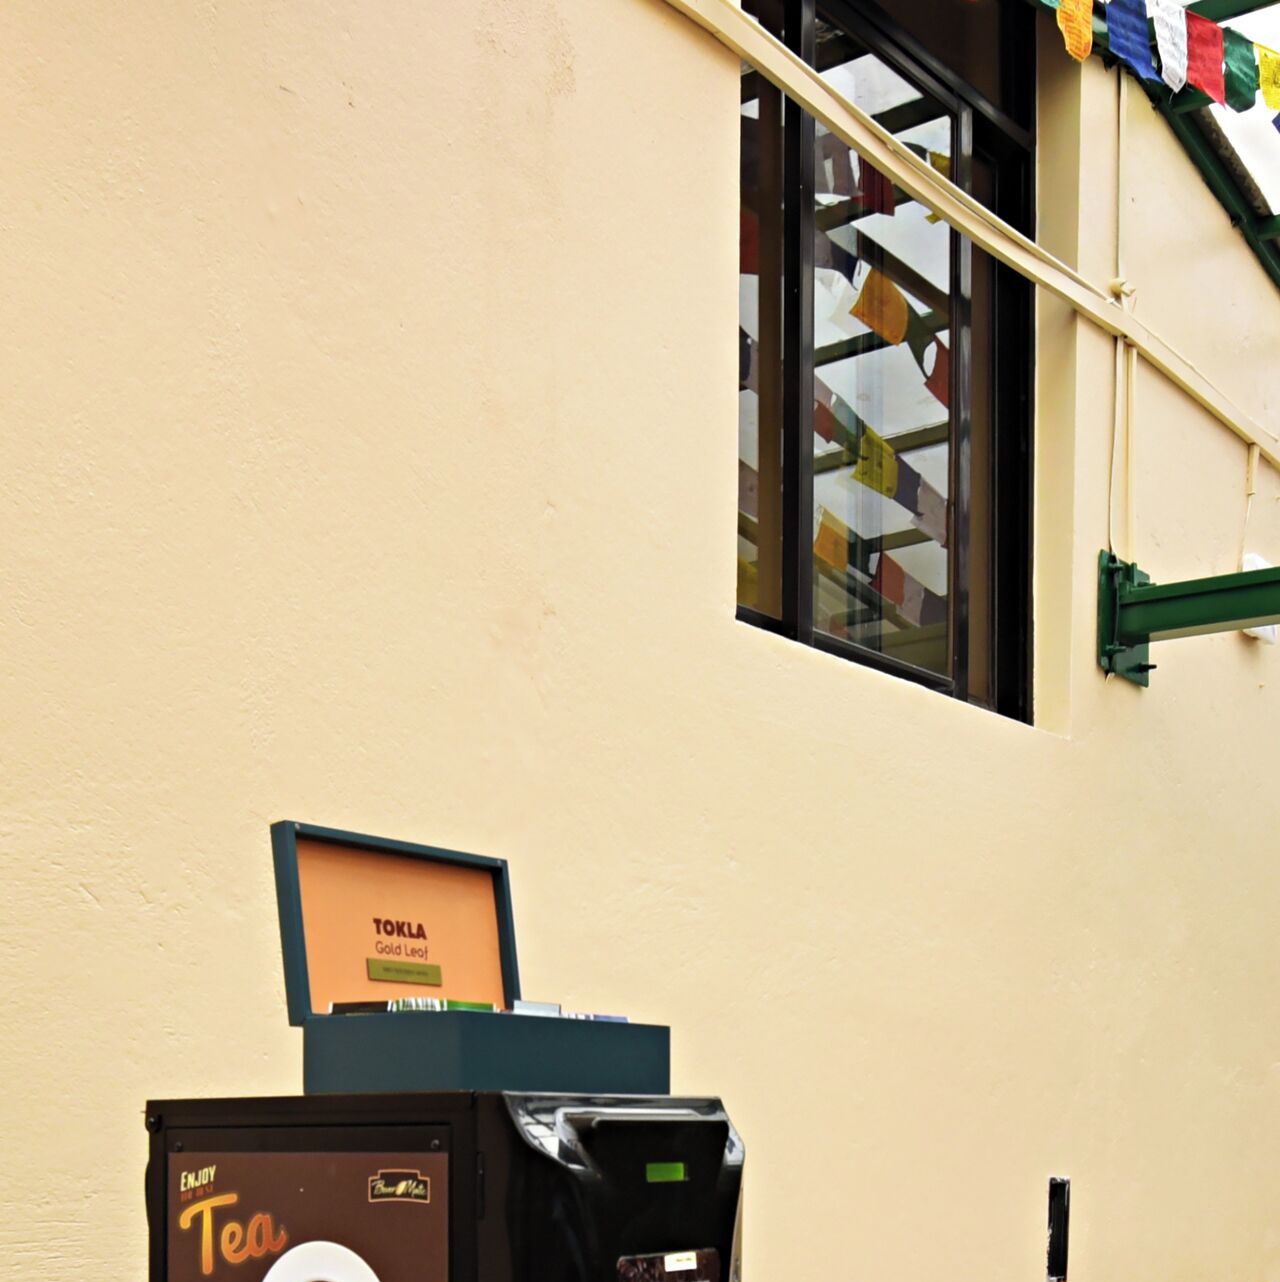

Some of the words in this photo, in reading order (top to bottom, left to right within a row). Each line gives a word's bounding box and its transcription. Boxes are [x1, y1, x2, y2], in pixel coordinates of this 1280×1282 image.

[373, 917, 427, 940] TOKLA
[375, 941, 402, 956] Gold
[404, 944, 428, 960] Leaf
[180, 1165, 216, 1192] ENJOY
[179, 1193, 287, 1275] Tea
